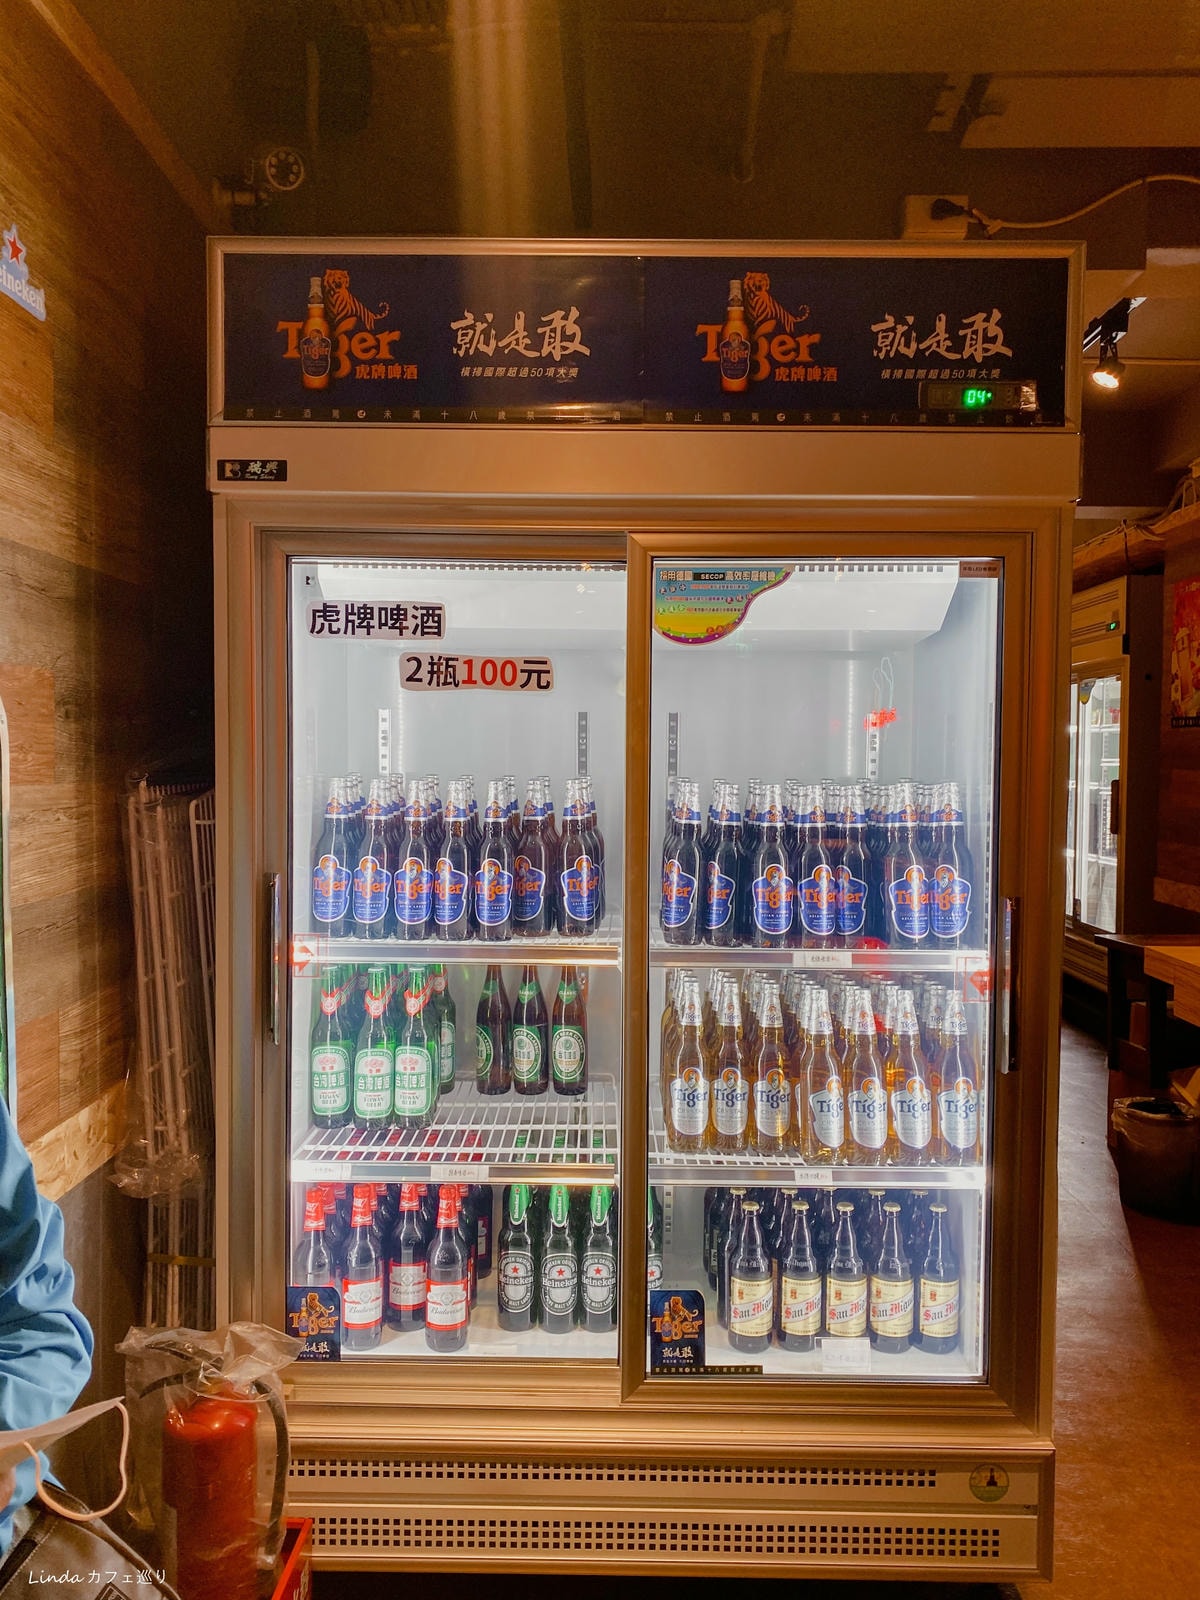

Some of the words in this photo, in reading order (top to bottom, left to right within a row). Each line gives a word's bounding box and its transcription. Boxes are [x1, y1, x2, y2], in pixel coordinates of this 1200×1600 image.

[0, 264, 45, 314] ineken
[450, 306, 591, 361] 就是敢
[871, 308, 1013, 361] 就是敢
[276, 317, 400, 379] Tger
[696, 319, 820, 381] Tger
[355, 363, 418, 380] 虎牌啤酒
[775, 365, 838, 382] 虎牌啤酒
[700, 572, 724, 580] SECOP
[309, 602, 443, 638] 虎牌啤酒
[405, 655, 551, 690] 2瓶100元
[313, 877, 348, 897] Tiger
[354, 878, 387, 899] Tiger
[396, 879, 431, 899] Tiger
[475, 880, 510, 901] Tiger
[516, 877, 541, 897] iger
[756, 887, 793, 909] Tiger
[675, 1088, 708, 1108] Tiger
[713, 1088, 748, 1108] Tiger
[757, 1089, 792, 1109] Tiger
[817, 1100, 843, 1119] Tige
[853, 1100, 887, 1119] Tiger
[897, 1100, 930, 1119] Tiger
[944, 1100, 978, 1120] Tiger
[542, 1277, 578, 1289] Heineken
[733, 1307, 750, 1319] San
[785, 1306, 803, 1319] San
[828, 1306, 848, 1320] San
[872, 1305, 888, 1318] San
[923, 1308, 943, 1321] San
[289, 1312, 339, 1335] Tger
[652, 1317, 702, 1340] Tger
